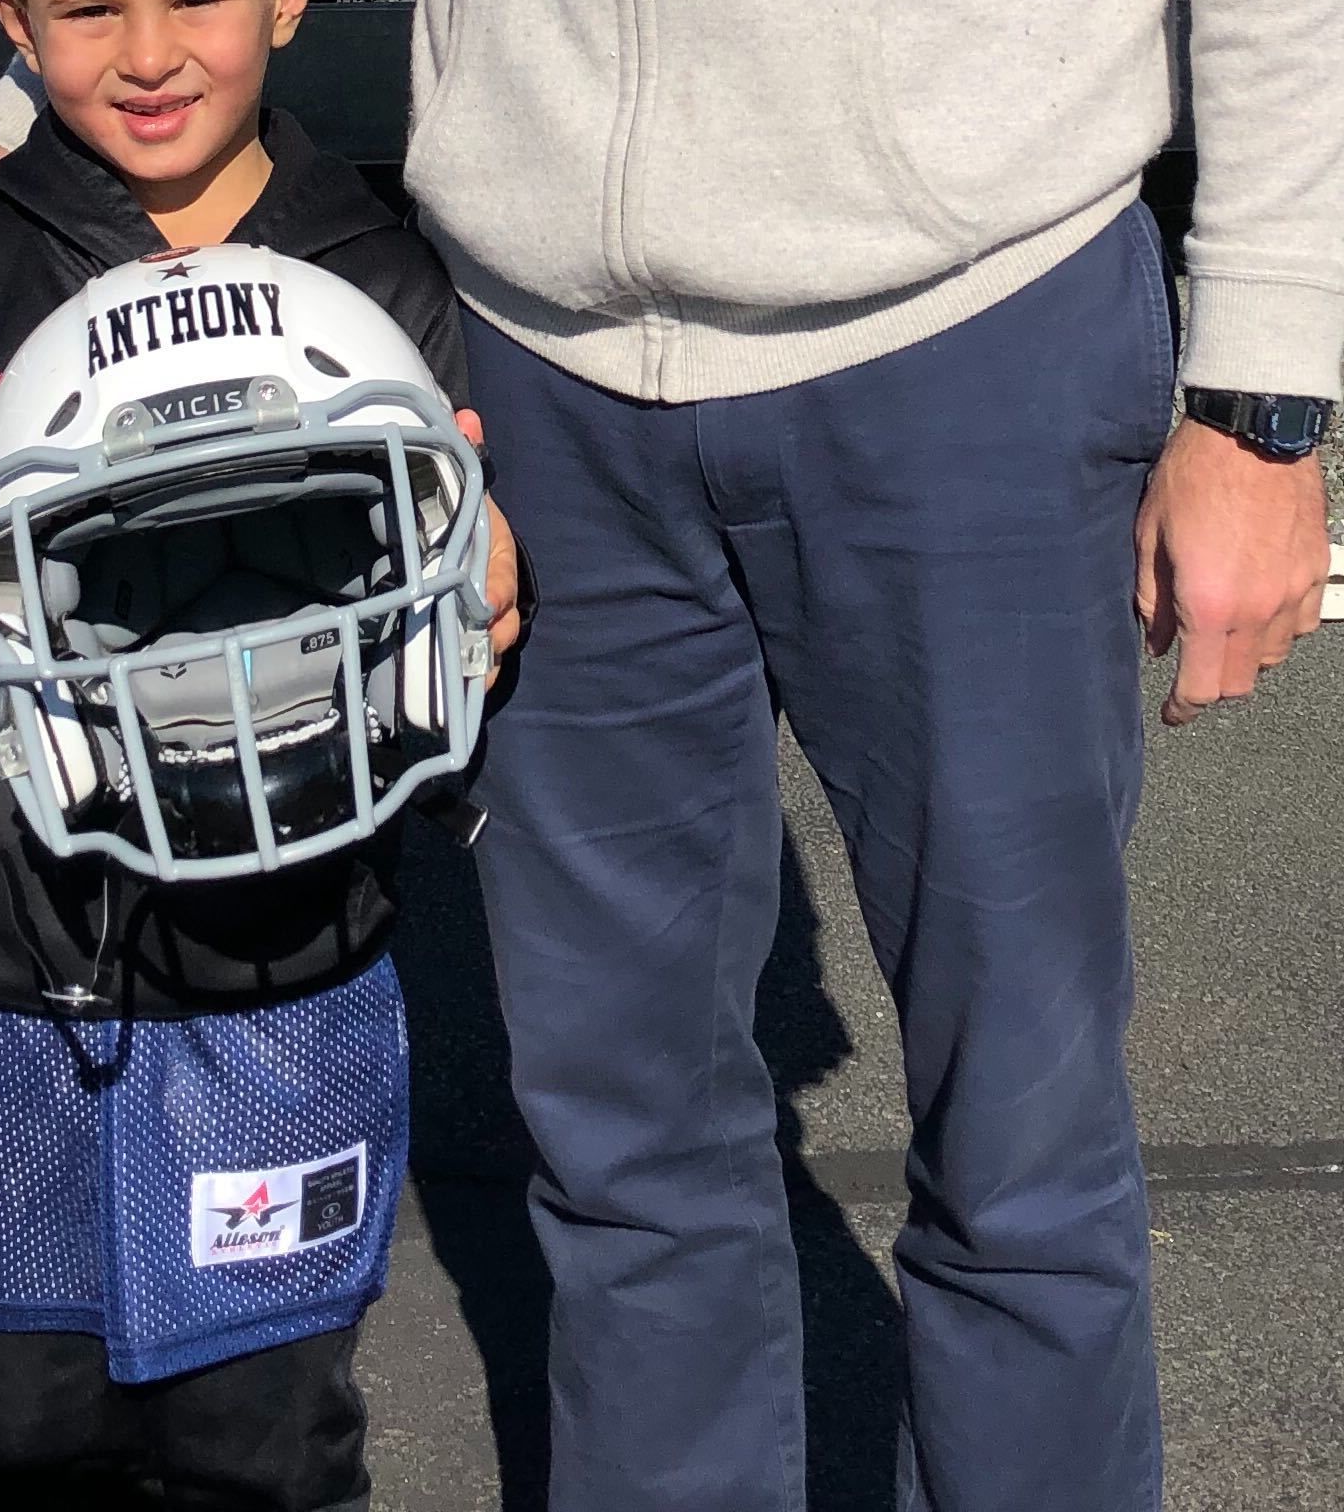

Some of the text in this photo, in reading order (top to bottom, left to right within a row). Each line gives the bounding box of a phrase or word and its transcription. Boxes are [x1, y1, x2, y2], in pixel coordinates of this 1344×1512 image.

[87, 282, 285, 379] ANTHONY
[151, 390, 243, 424] VICIS
[305, 631, 335, 651] .875
